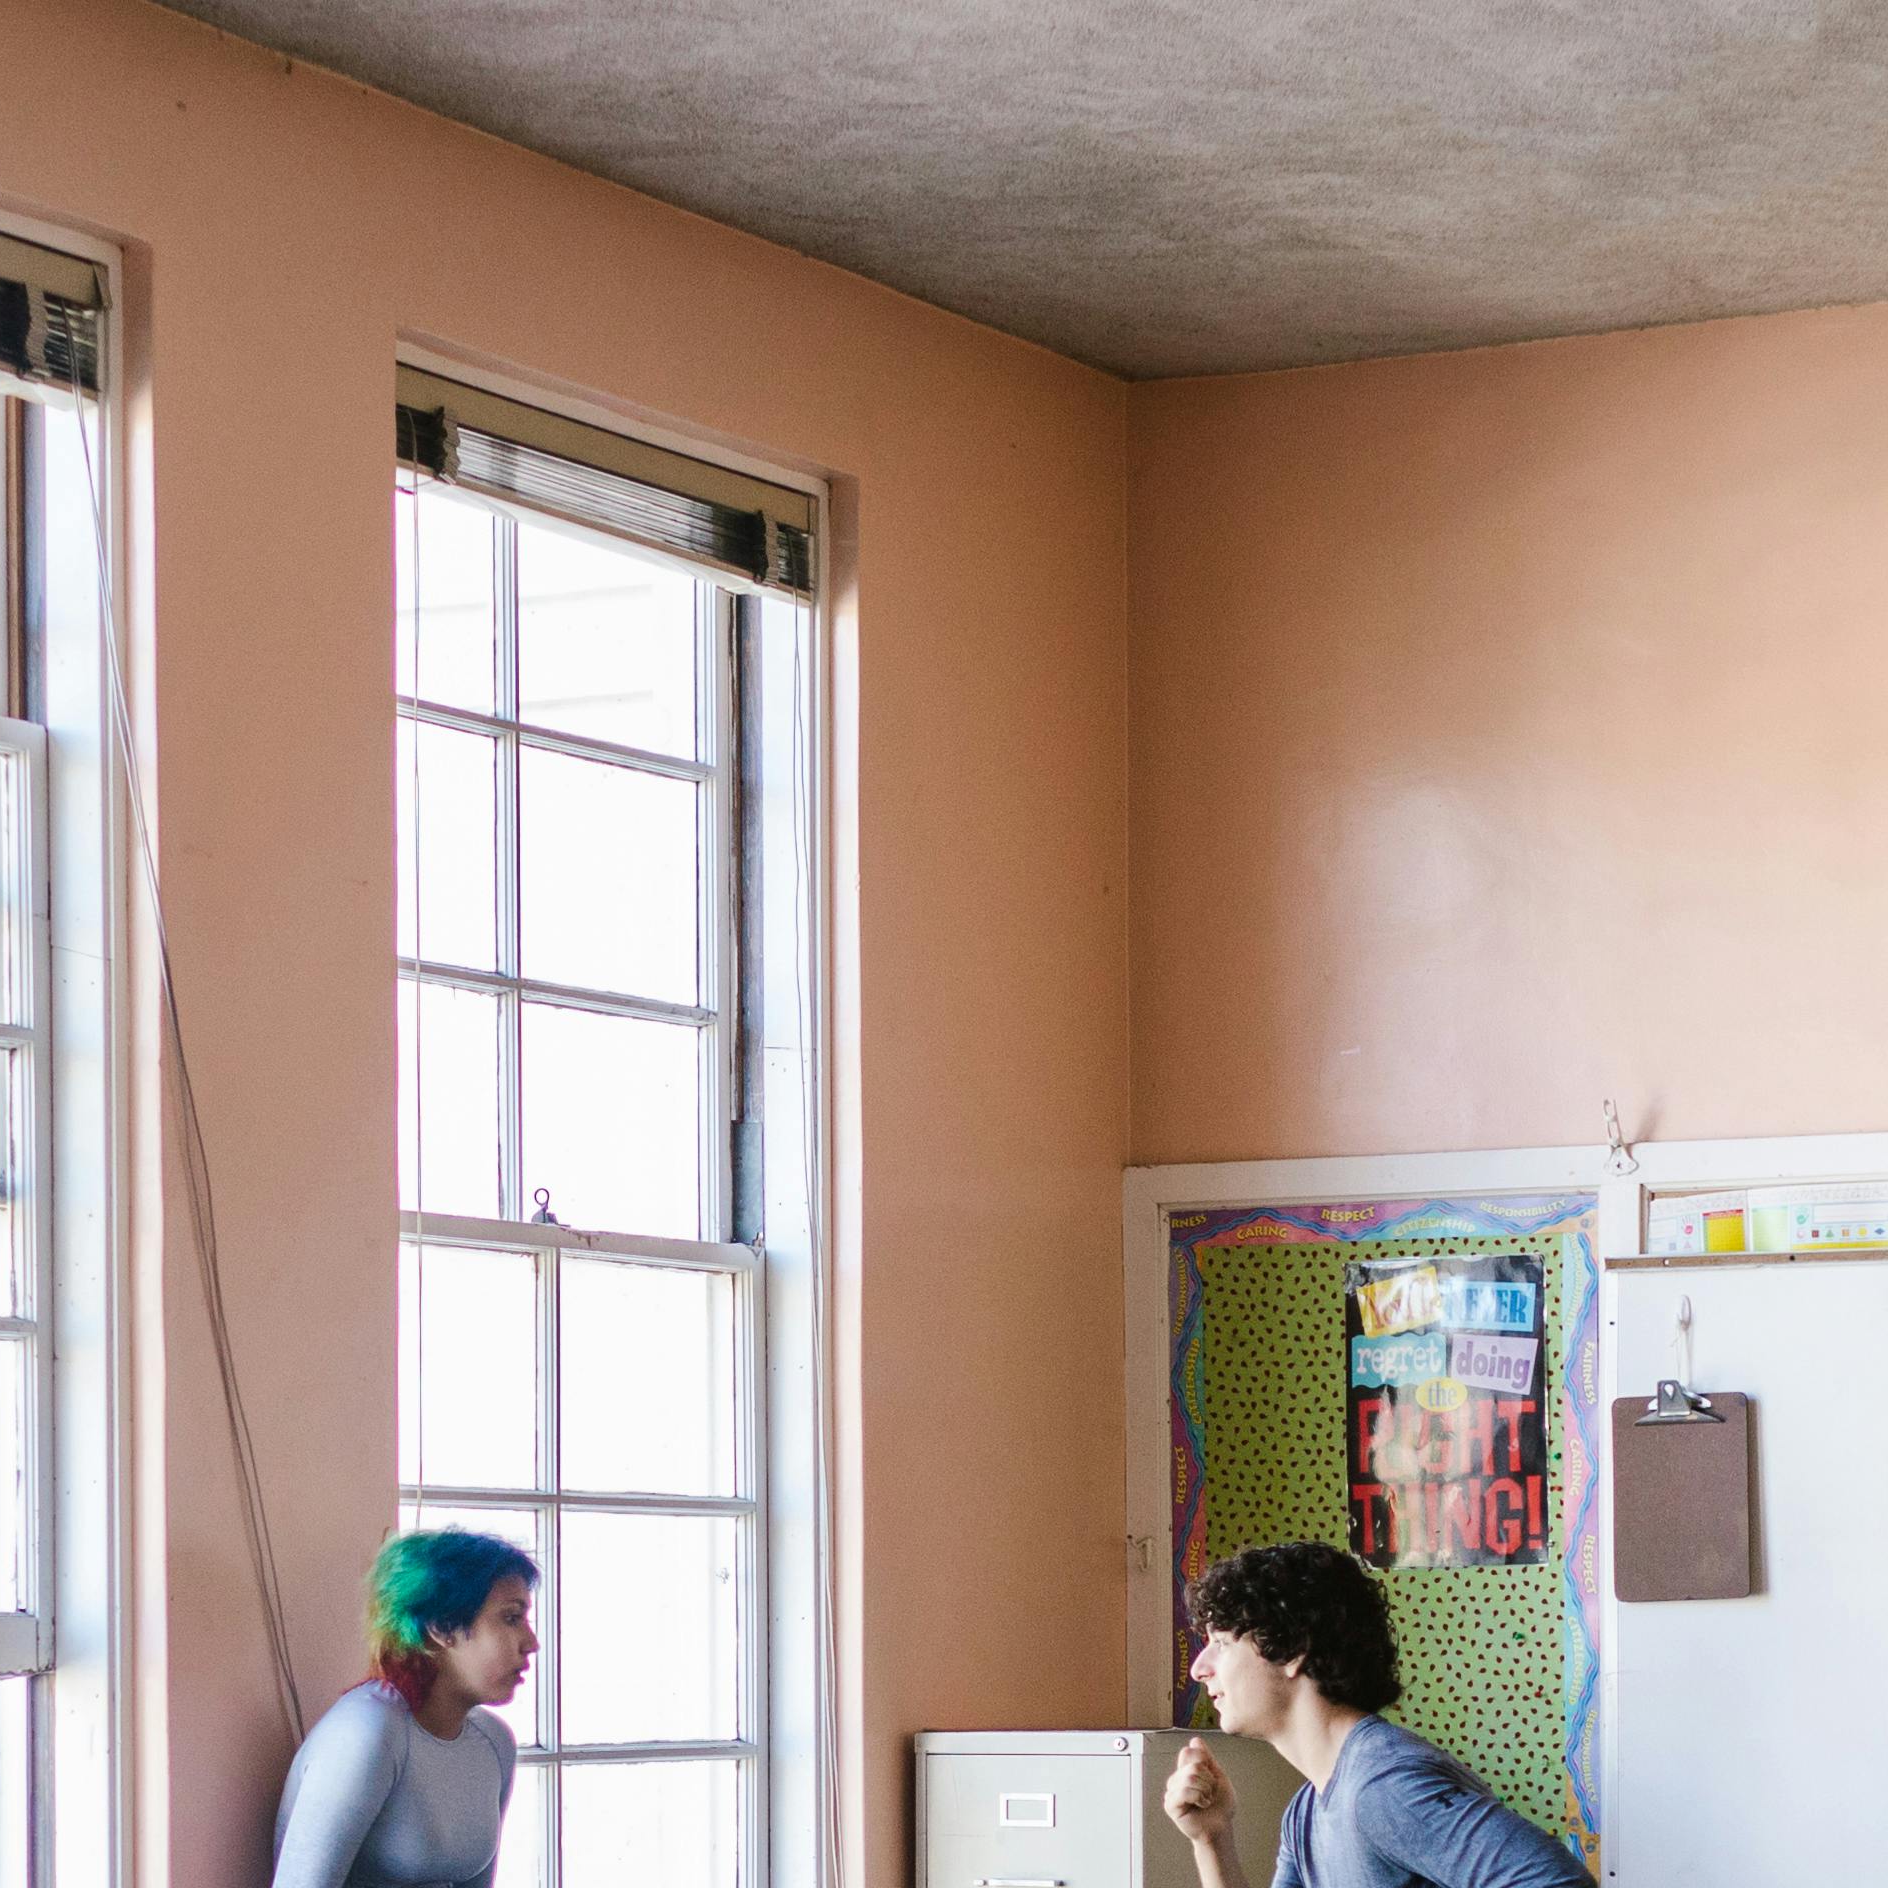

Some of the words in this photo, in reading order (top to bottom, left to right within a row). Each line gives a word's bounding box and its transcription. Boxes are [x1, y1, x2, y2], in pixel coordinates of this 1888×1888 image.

[1236, 1225, 1289, 1241] CARING
[1321, 1206, 1376, 1222] RESPECT
[1479, 1199, 1567, 1219] RESPONSIBILITY
[1357, 1342, 1442, 1378] regret
[1456, 1341, 1531, 1390] doing
[1428, 1381, 1458, 1408] the
[1581, 1341, 1597, 1405] FAIRNESS
[1358, 1398, 1537, 1475] RIGHT
[1175, 1445, 1188, 1504] RESPECT
[1569, 1438, 1583, 1497] CARING
[1352, 1474, 1544, 1556] THING!
[1188, 1540, 1201, 1581] RING
[1583, 1534, 1598, 1594] RESPECT
[1176, 1629, 1191, 1690] FAIRNESS
